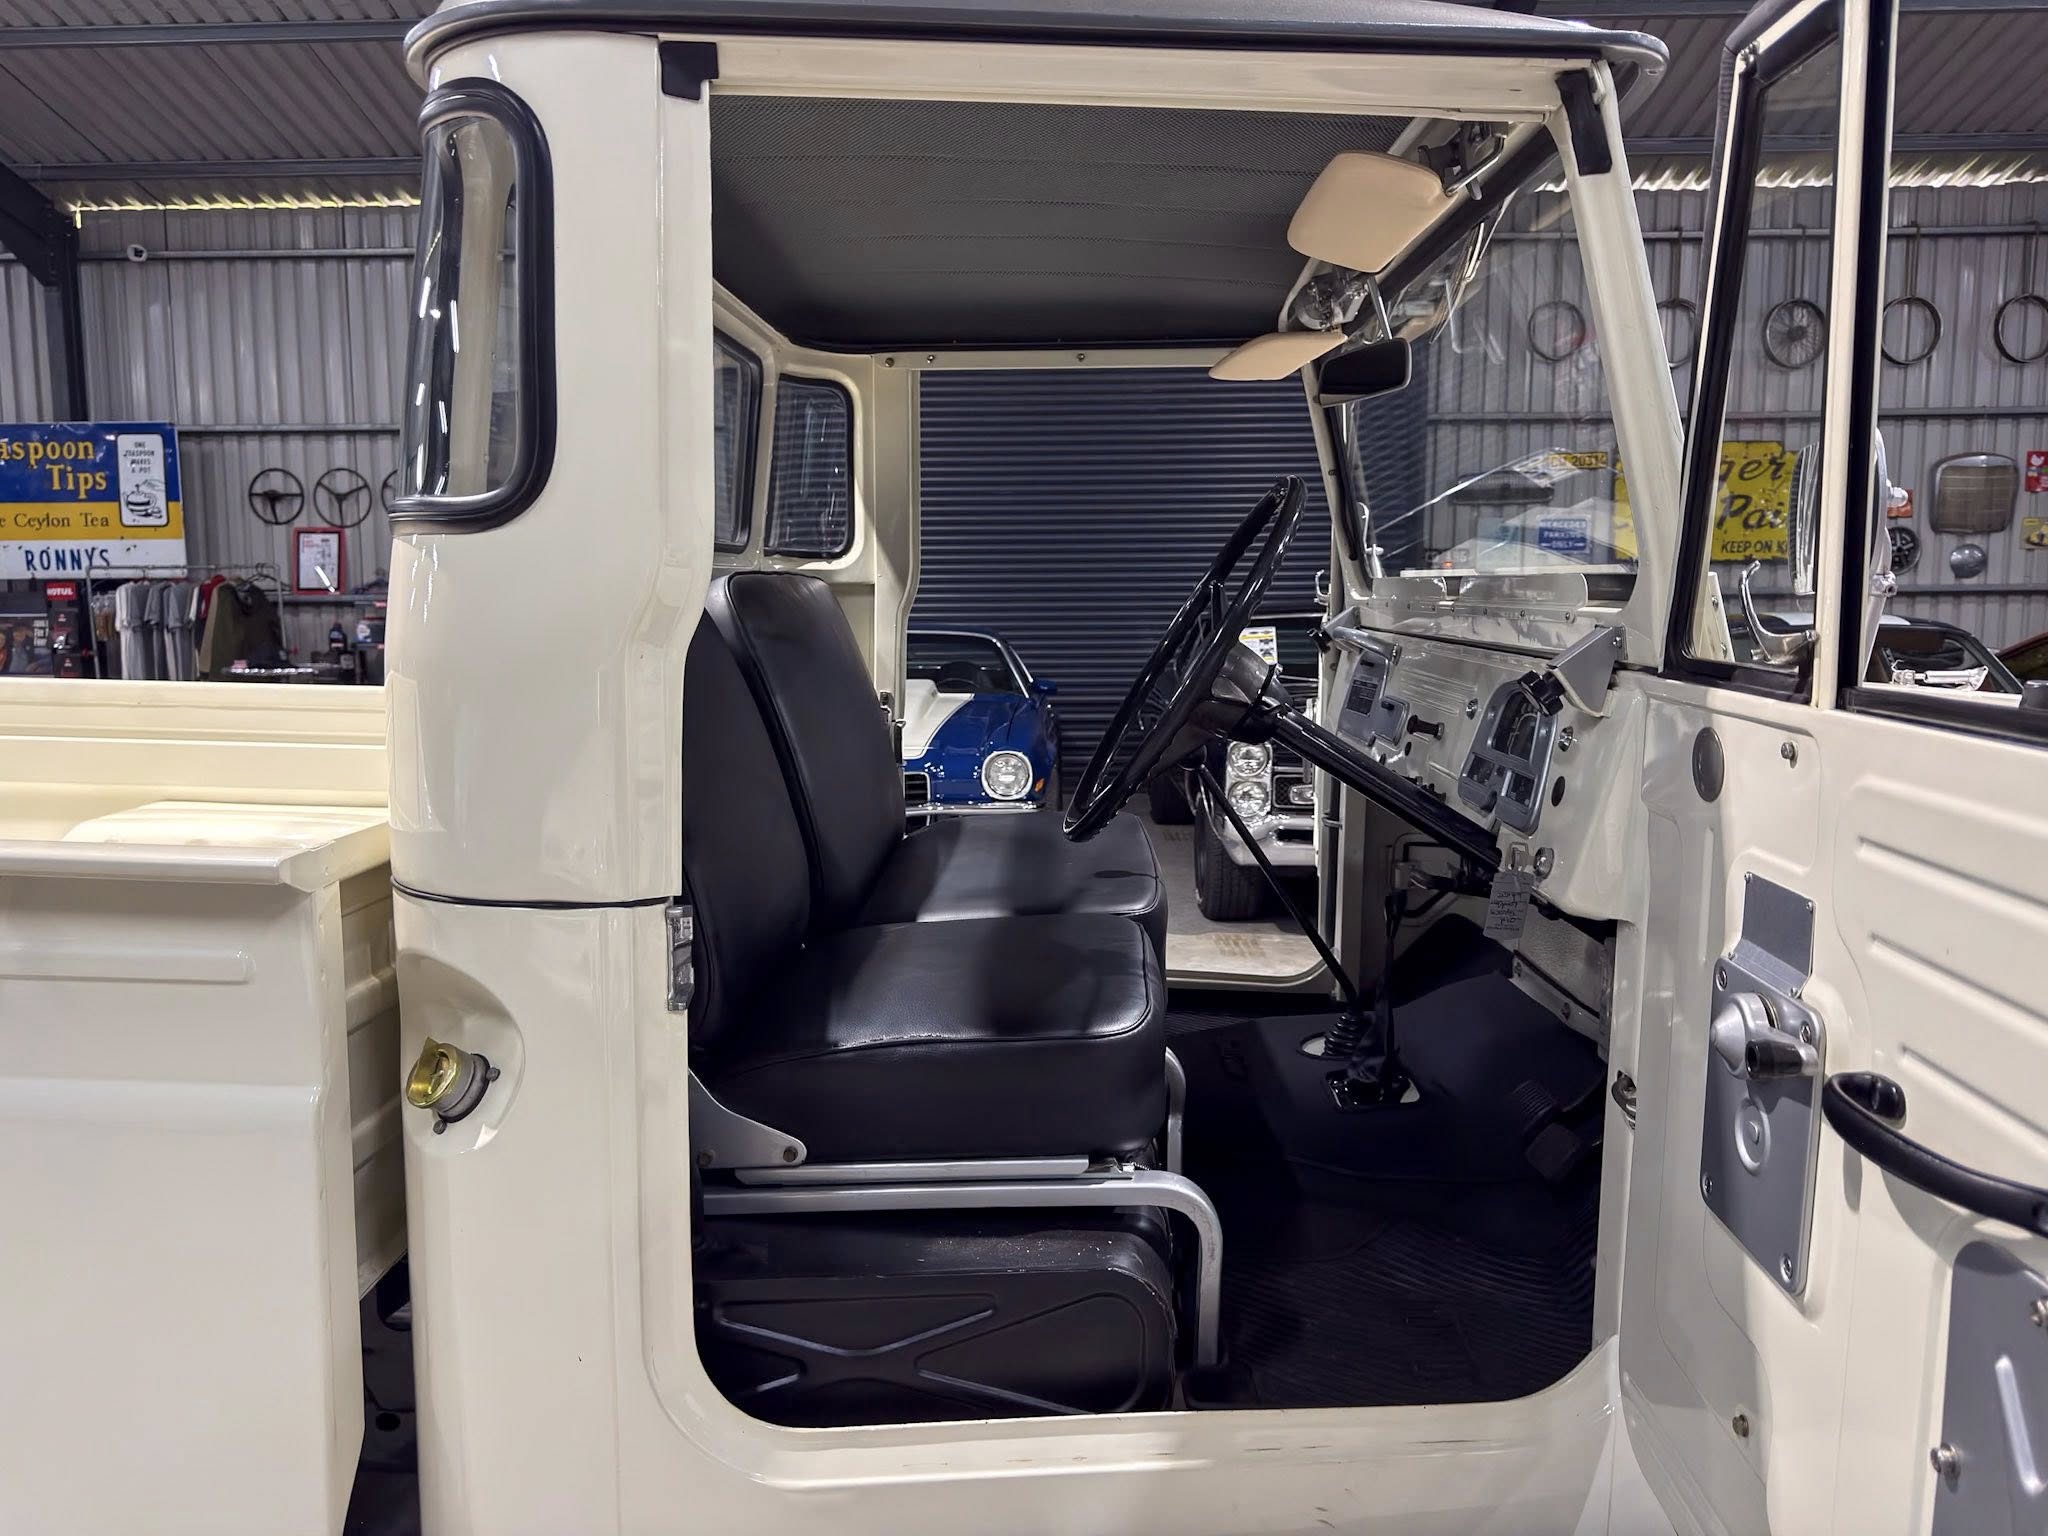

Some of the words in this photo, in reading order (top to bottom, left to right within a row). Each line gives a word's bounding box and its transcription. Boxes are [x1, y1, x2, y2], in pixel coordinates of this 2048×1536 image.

[45, 464, 107, 499] Tips
[13, 512, 70, 530] Ceylon
[79, 512, 109, 527] Tea
[1721, 540, 1752, 553] KEEP
[1754, 540, 1773, 552] ON
[25, 548, 110, 571] RONNYS
